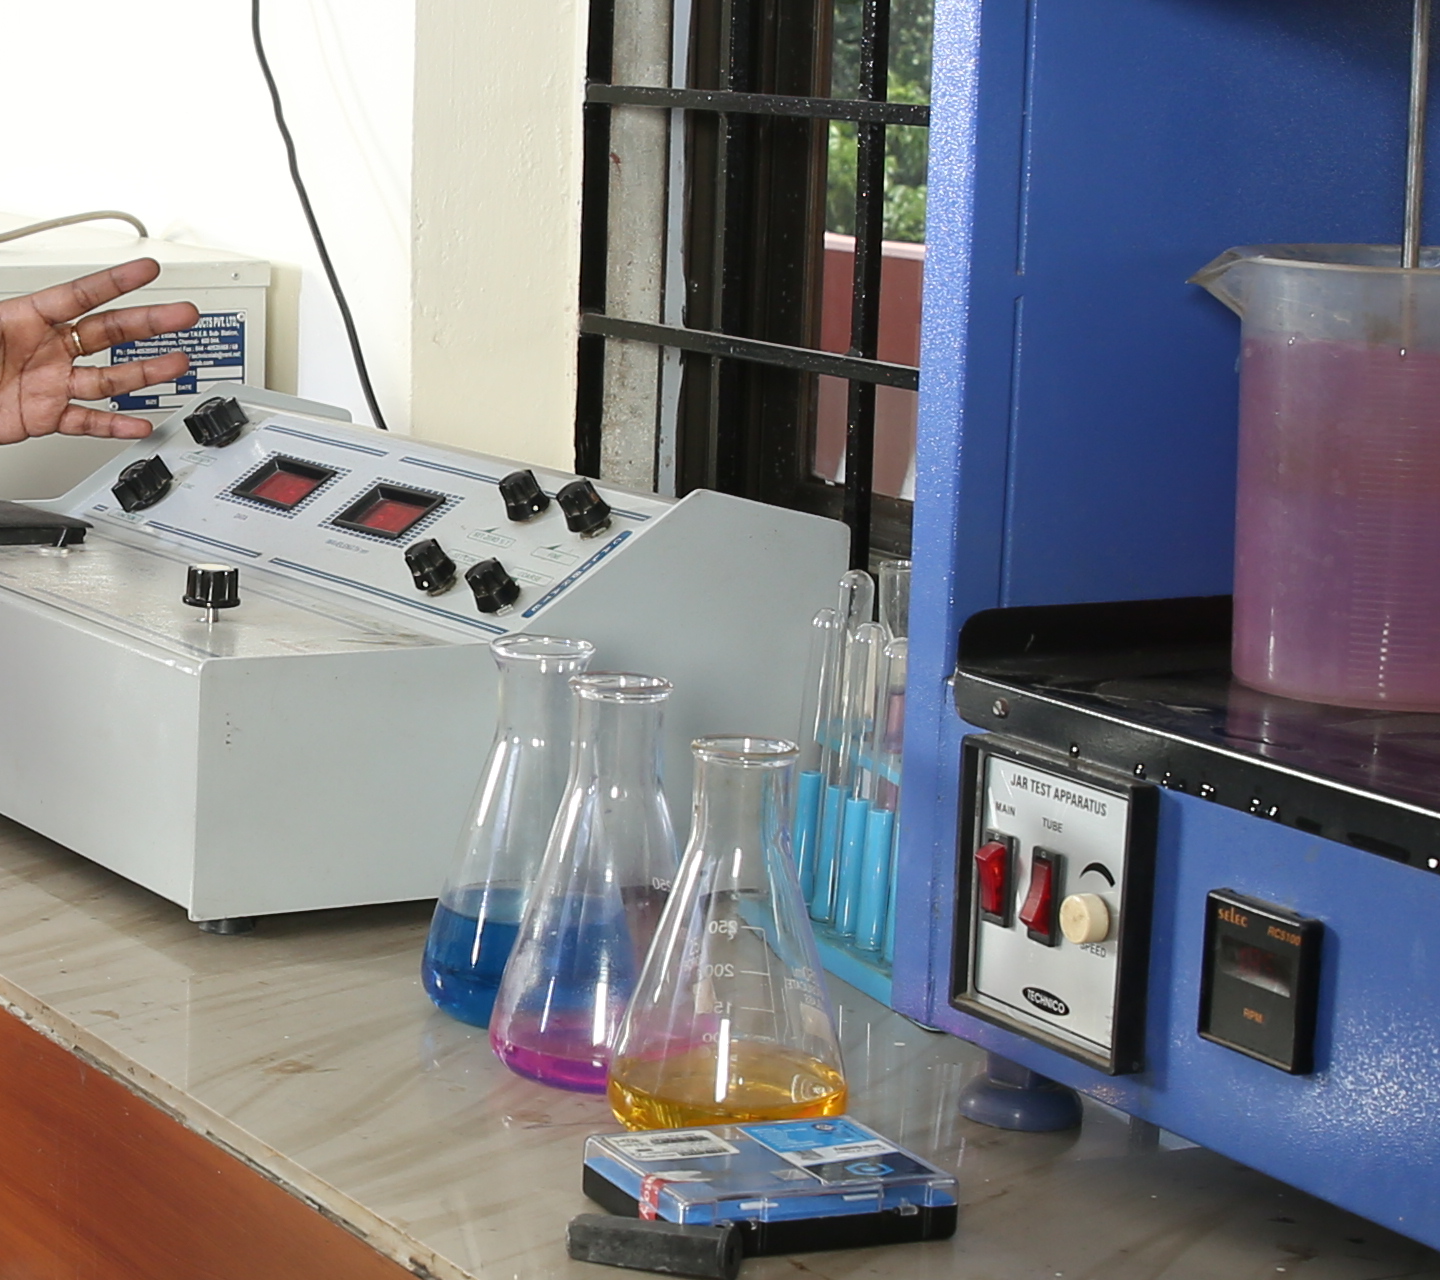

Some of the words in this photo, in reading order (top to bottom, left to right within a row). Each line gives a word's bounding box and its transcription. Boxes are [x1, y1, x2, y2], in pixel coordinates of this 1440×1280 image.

[1010, 773, 1029, 790] JAR
[1030, 778, 1052, 798] TEST
[1052, 786, 1108, 817] APPARATUS
[995, 801, 1016, 817] MAIN
[1042, 816, 1064, 834] TUBE
[1027, 989, 1066, 1014] TECHNICO
